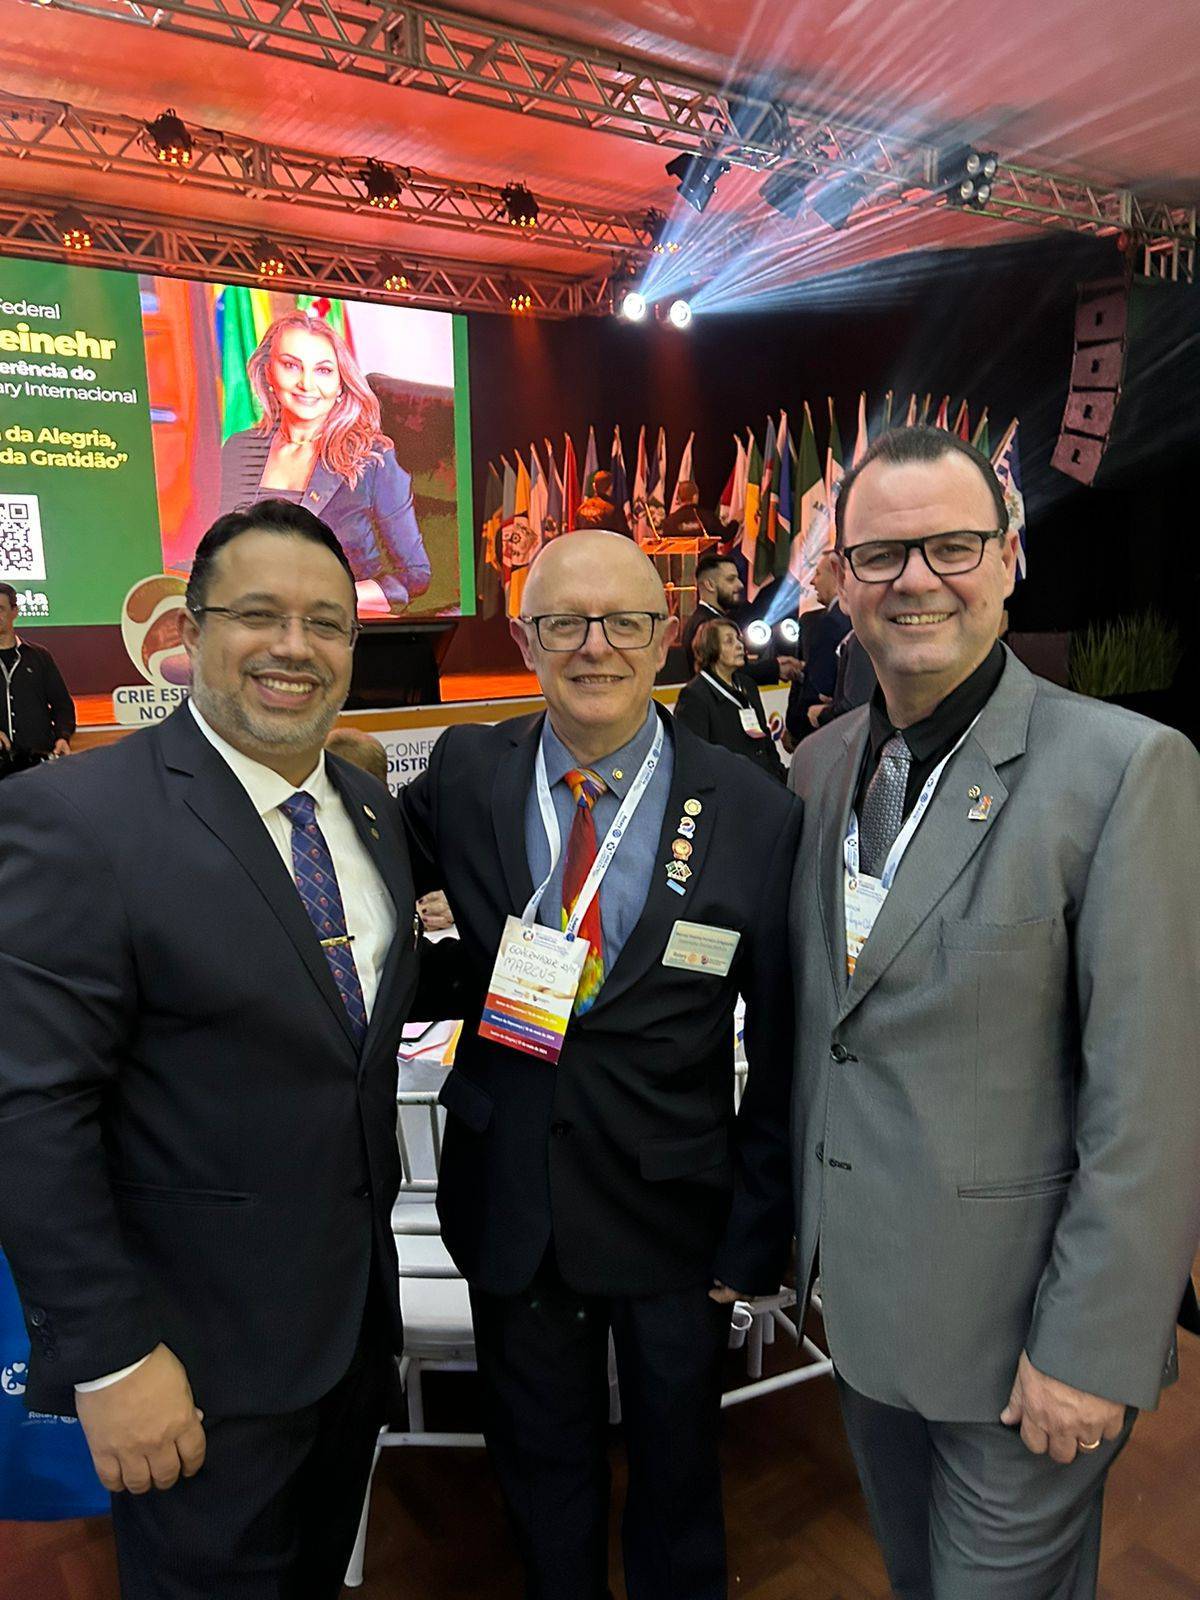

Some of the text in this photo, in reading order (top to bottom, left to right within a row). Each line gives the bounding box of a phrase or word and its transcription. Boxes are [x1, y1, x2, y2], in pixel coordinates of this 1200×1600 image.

[0, 298, 61, 319] ederal
[70, 365, 97, 381] do
[25, 381, 138, 404] Internacional
[5, 425, 118, 450] da Alegria,
[0, 447, 28, 465] da
[116, 687, 189, 704] CRIE ESP
[139, 705, 167, 720] NO
